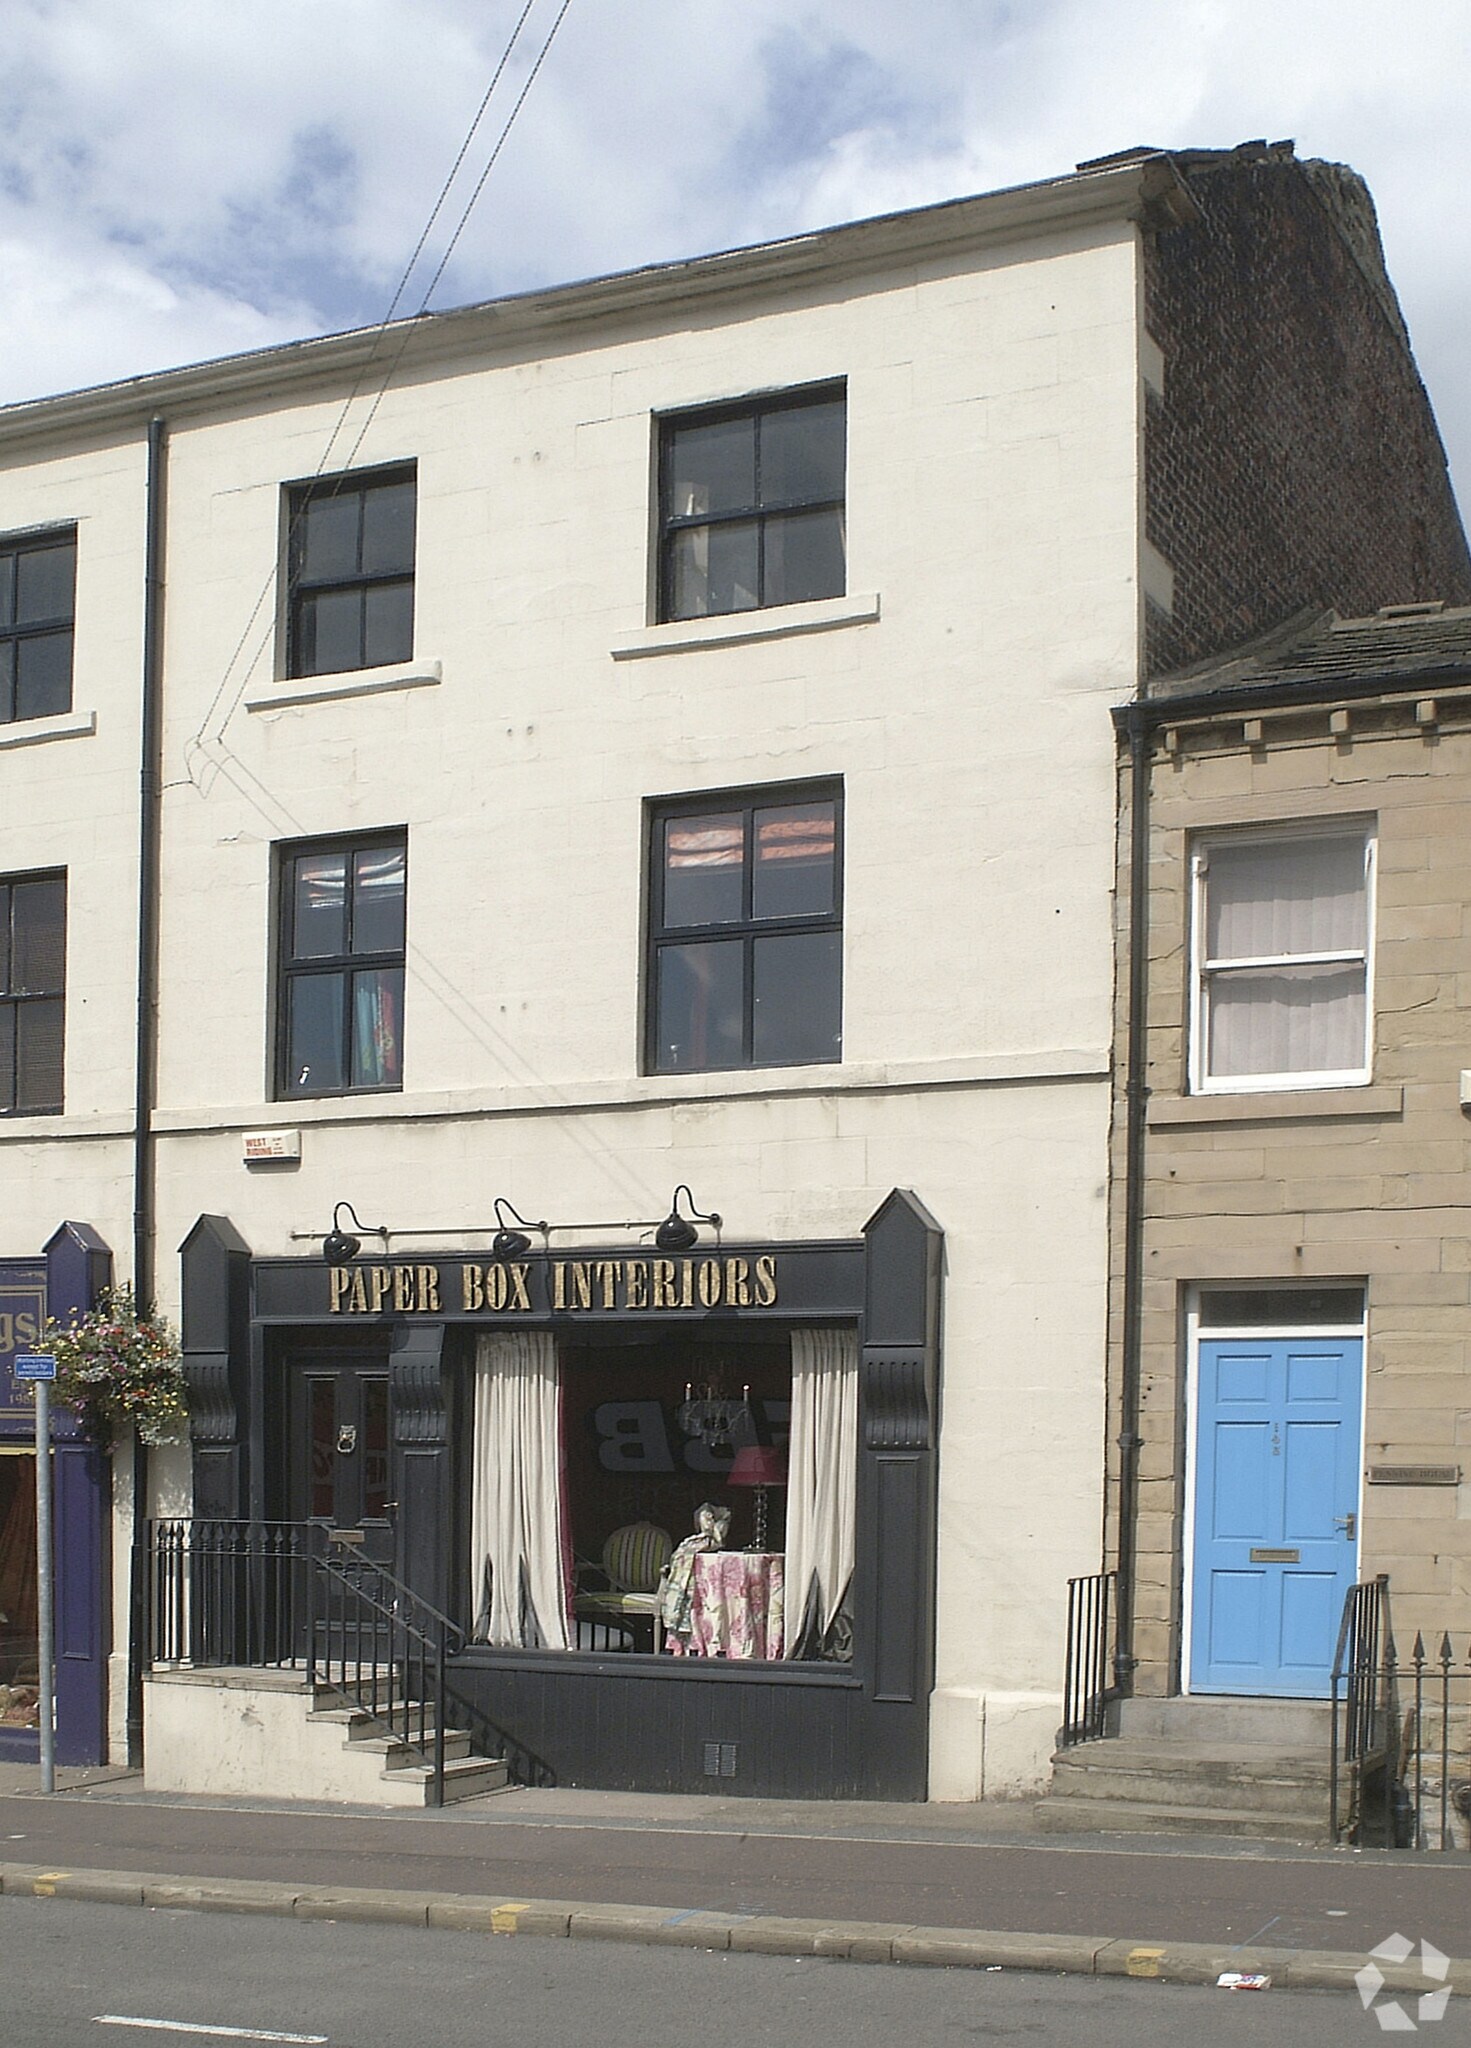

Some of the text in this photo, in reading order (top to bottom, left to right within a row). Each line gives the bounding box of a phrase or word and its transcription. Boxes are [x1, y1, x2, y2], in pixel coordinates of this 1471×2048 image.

[329, 1256, 778, 1312] PAPER BOX INTERIORS
